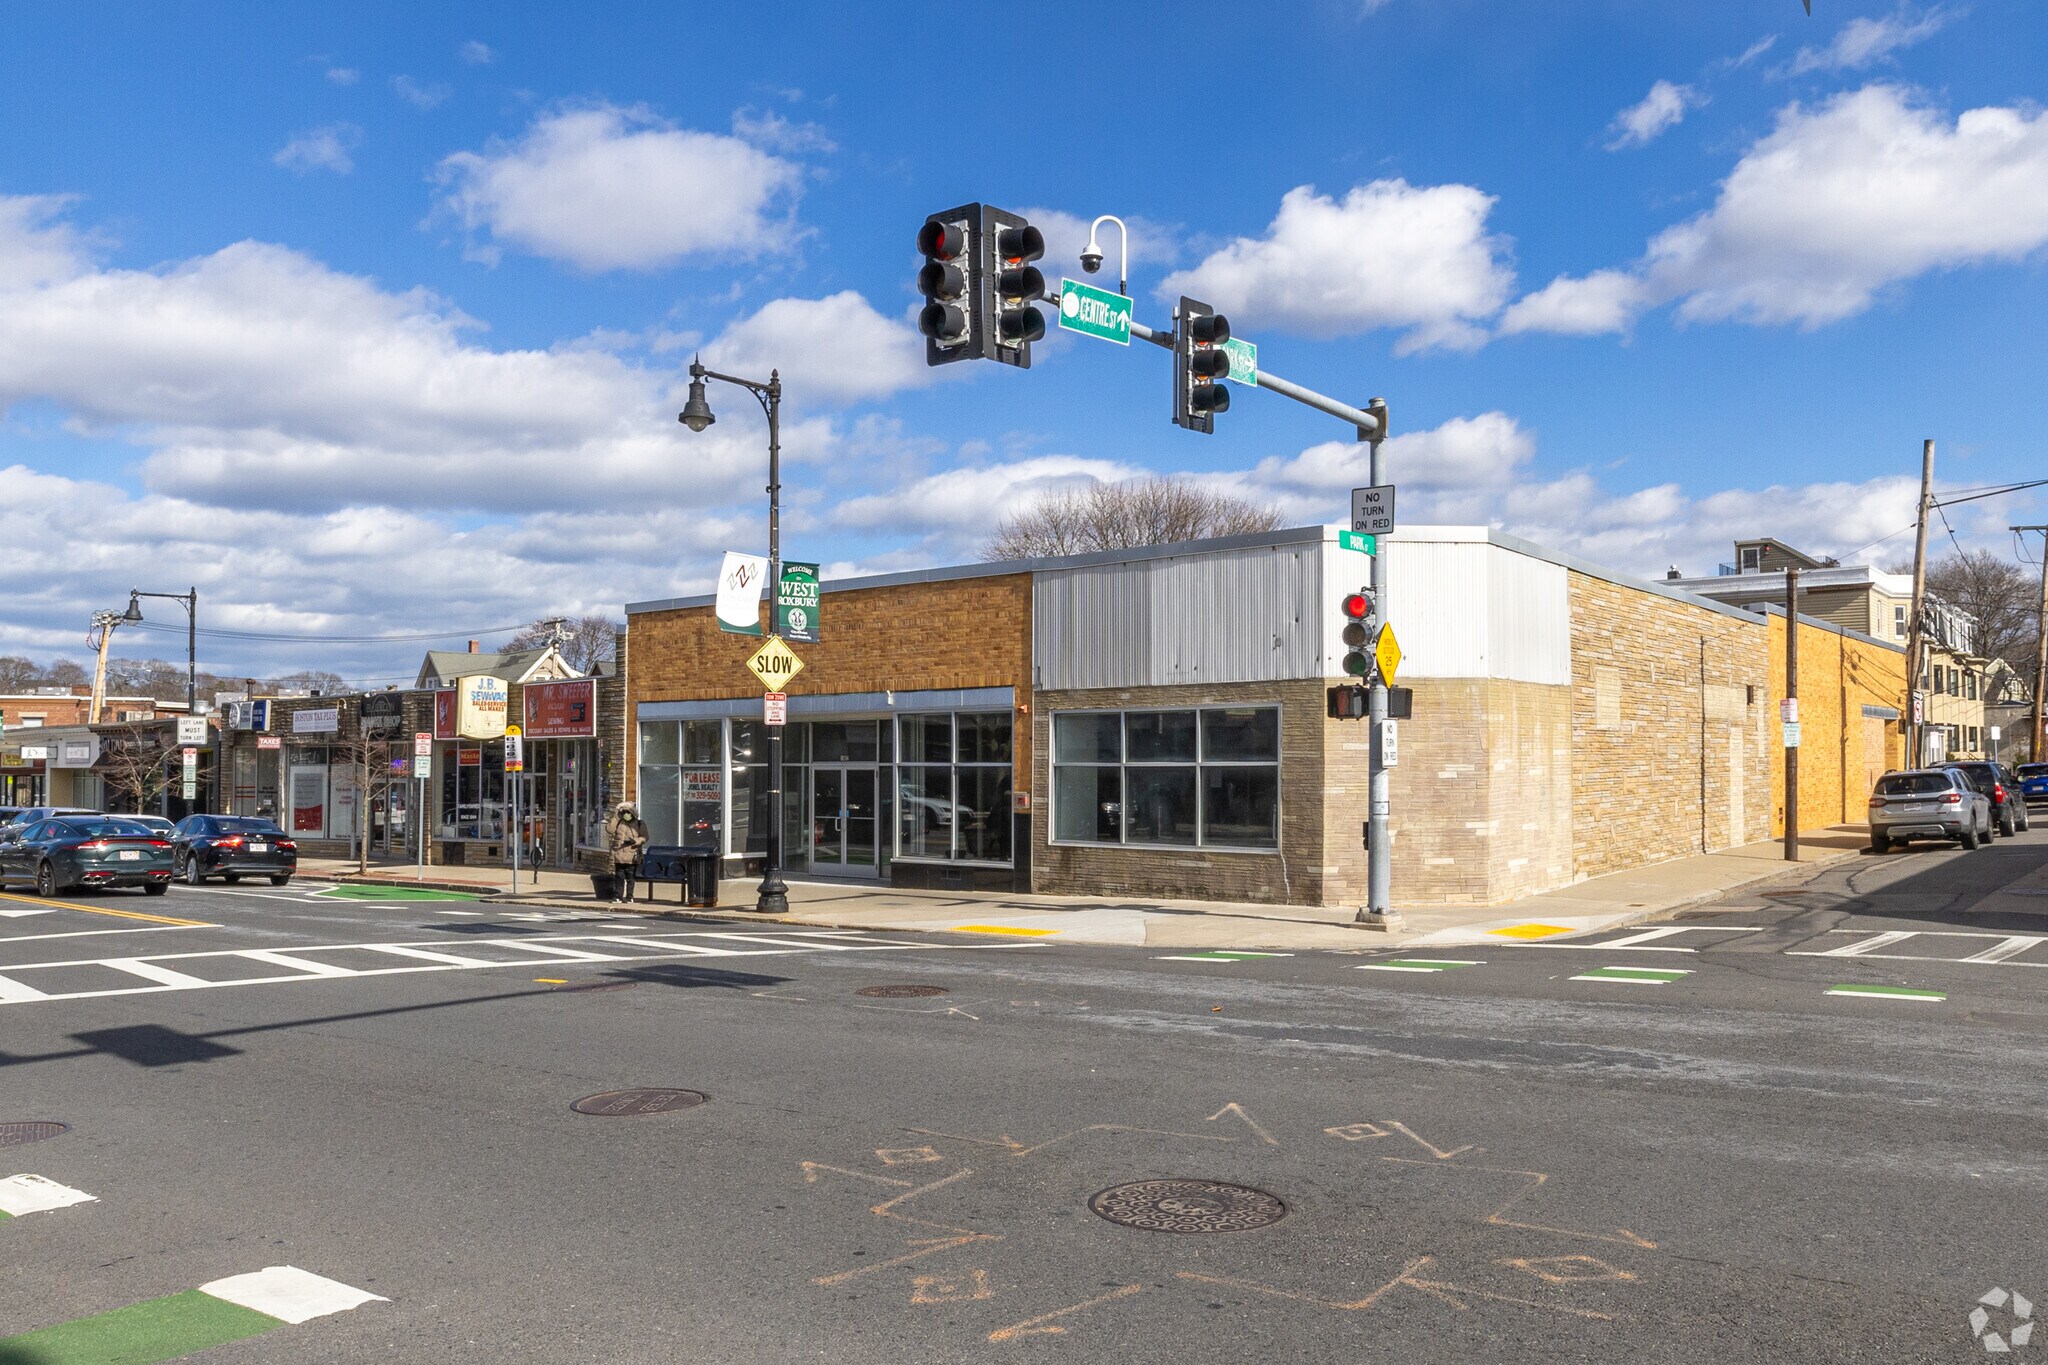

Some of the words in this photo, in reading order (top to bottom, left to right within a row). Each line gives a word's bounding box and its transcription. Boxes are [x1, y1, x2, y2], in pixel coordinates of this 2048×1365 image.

[1080, 296, 1110, 327] CENTRE
[1110, 311, 1117, 328] ST
[1366, 492, 1380, 503] NO
[1361, 505, 1385, 517] TURN
[1355, 520, 1367, 530] ON
[1372, 518, 1390, 529] RED
[1350, 535, 1364, 551] PARK
[787, 566, 813, 575] WELCOME
[780, 581, 819, 597] WEST
[778, 596, 818, 608] ROXBURY
[757, 656, 793, 674] SLOW
[1386, 656, 1392, 666] 25
[478, 678, 496, 690] J.B.
[543, 685, 556, 699] MR.
[559, 682, 591, 698] SWEEPER
[295, 713, 313, 721] BOSTON
[314, 712, 323, 720] TAX
[324, 711, 337, 720] PLUS
[1386, 723, 1393, 735] NO
[1386, 737, 1395, 747] TURN
[685, 772, 698, 783] FOR
[700, 772, 720, 783] LEASE
